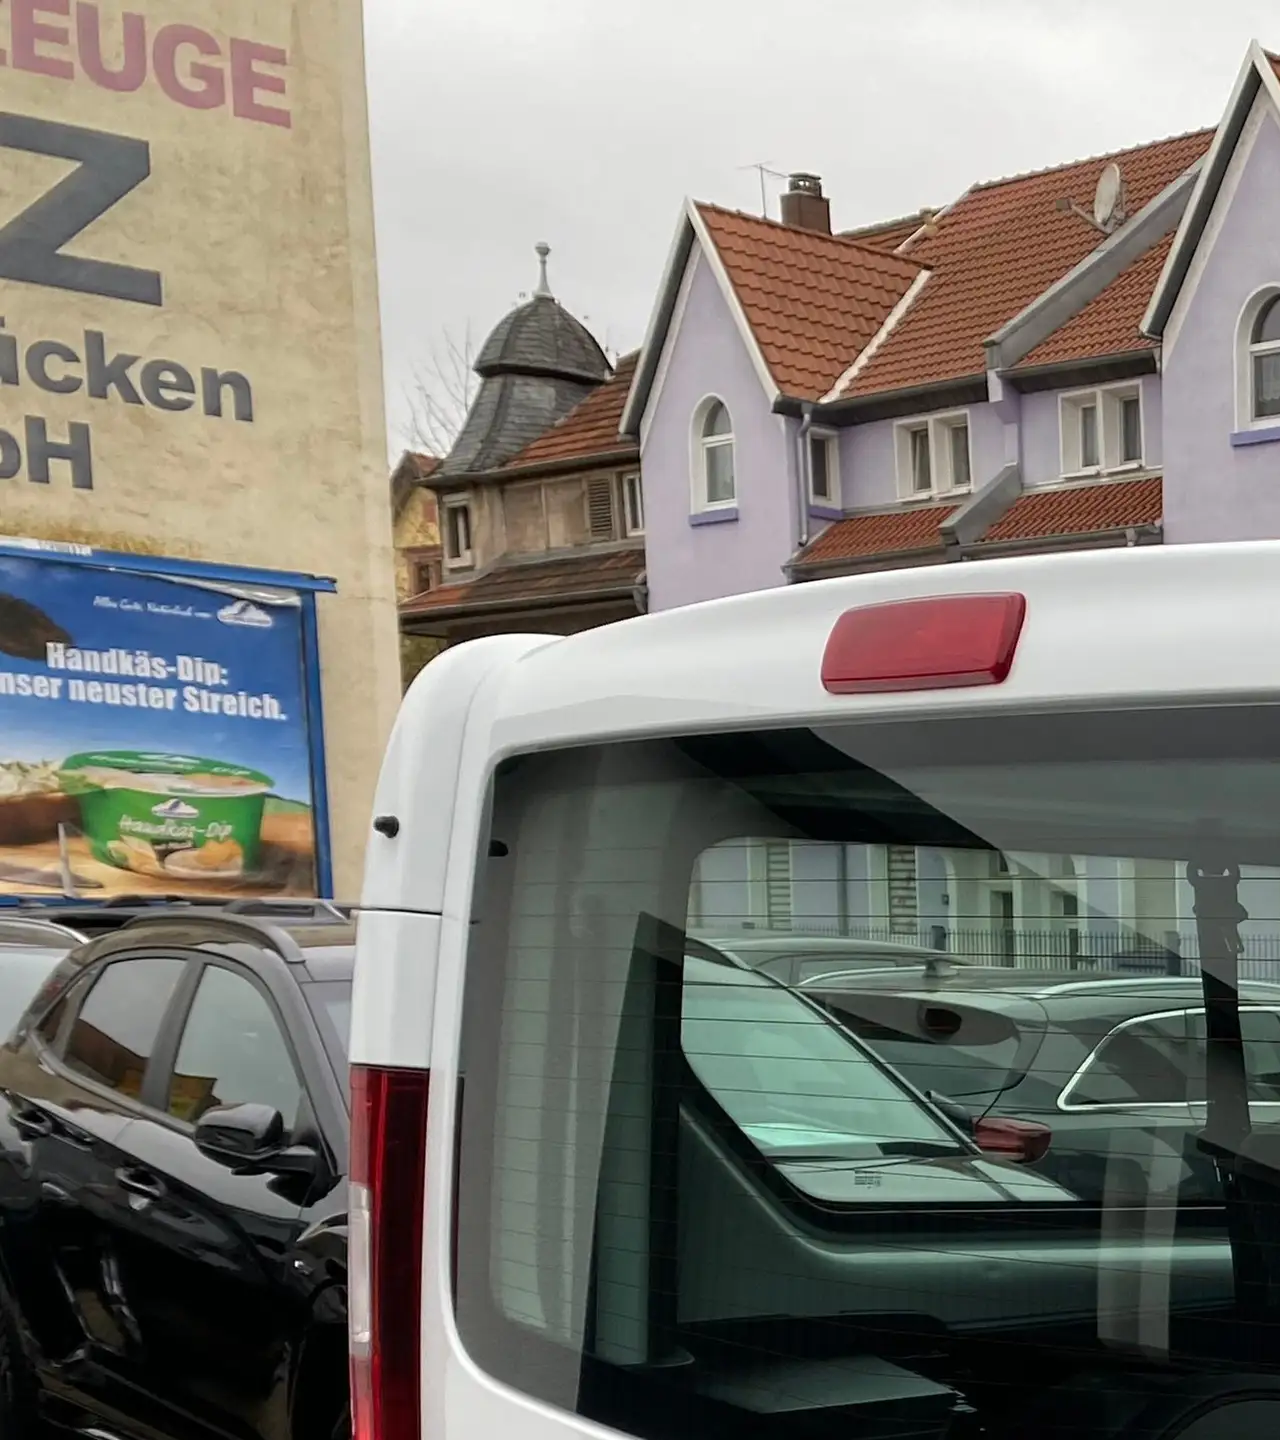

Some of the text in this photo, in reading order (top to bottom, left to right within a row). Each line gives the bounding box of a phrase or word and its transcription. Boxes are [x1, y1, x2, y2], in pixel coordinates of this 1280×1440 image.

[0, 0, 292, 128] EUGE
[46, 641, 229, 687] Handkäs-Dip:
[68, 679, 177, 711] neuster
[182, 685, 287, 720] Streich.
